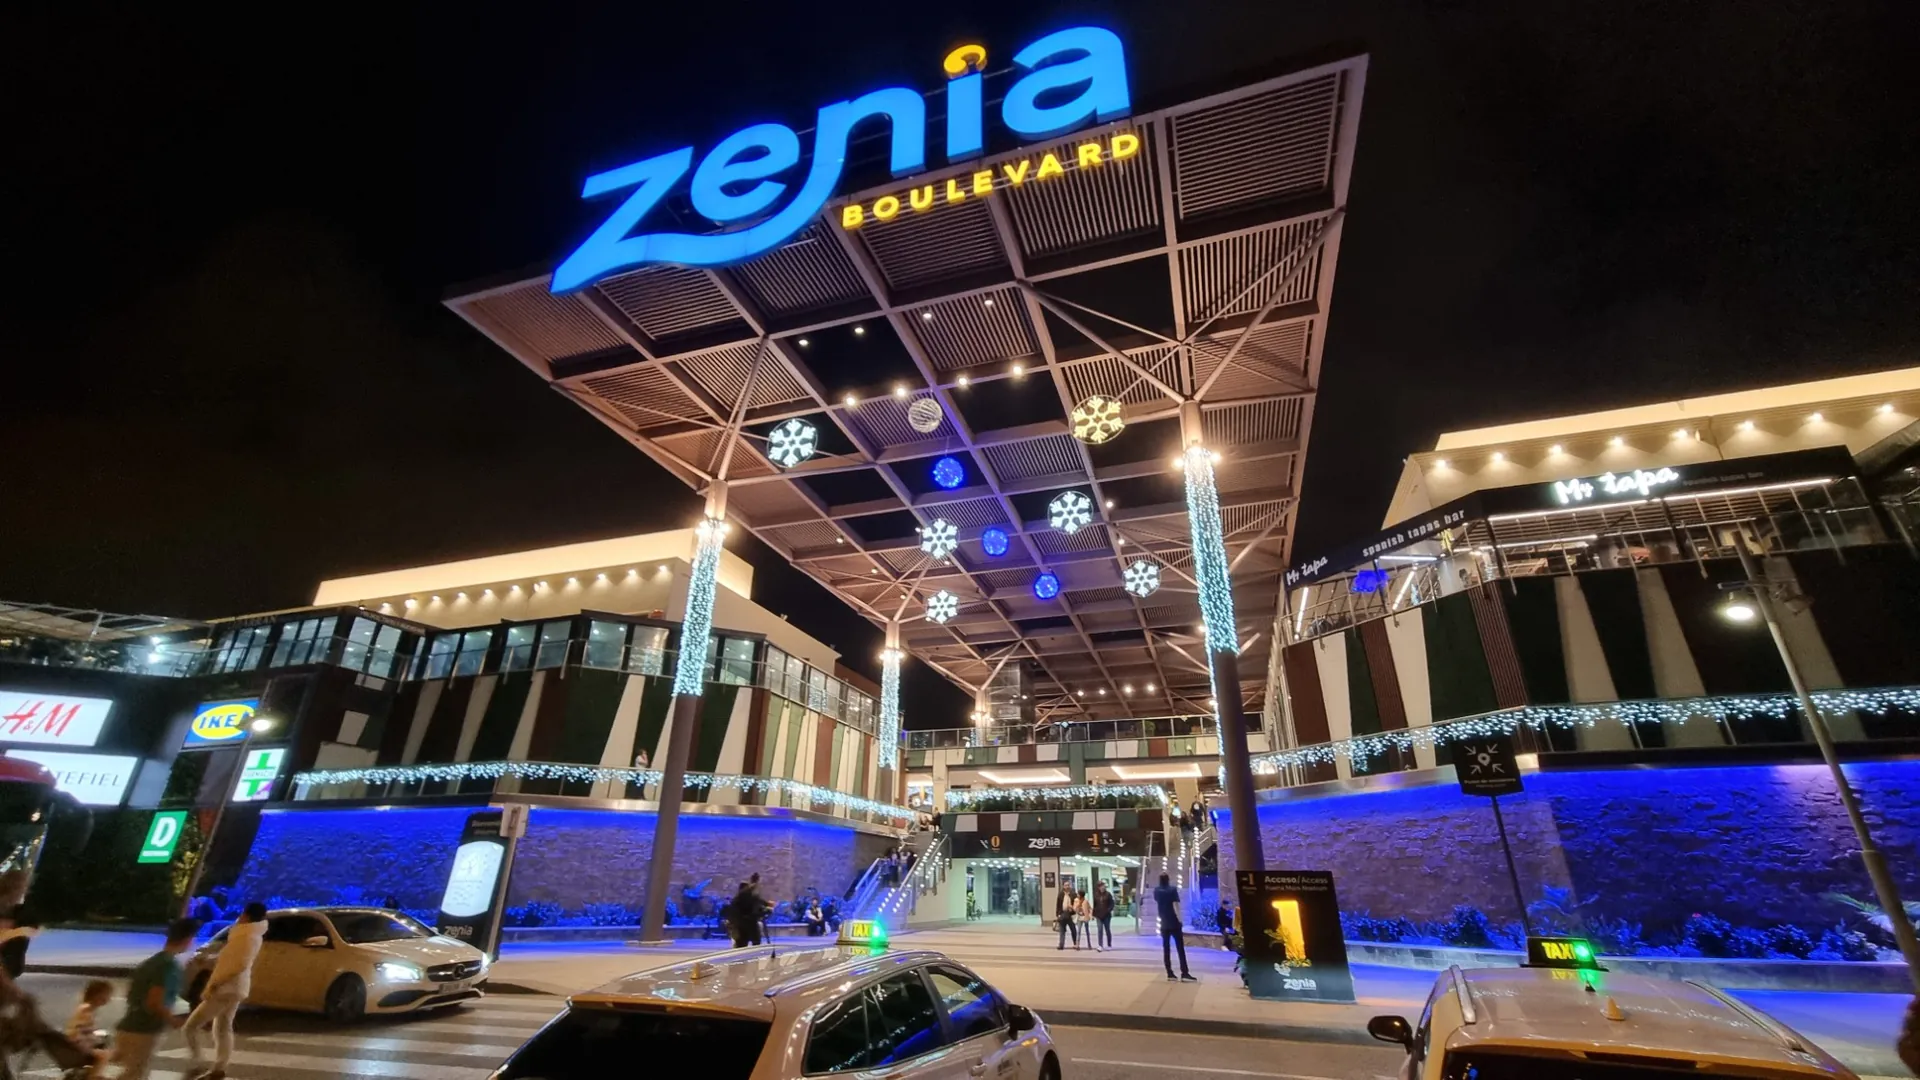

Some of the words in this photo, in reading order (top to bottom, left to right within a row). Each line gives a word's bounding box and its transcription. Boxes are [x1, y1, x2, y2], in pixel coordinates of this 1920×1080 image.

[549, 26, 1133, 294] zenia
[841, 133, 1140, 230] BOULEVARD
[1598, 467, 1680, 496] tapa
[1362, 533, 1405, 557] spanish
[1408, 519, 1440, 539] tapas
[1444, 509, 1465, 525] bar
[1302, 556, 1329, 577] tapa
[0, 700, 82, 737] H&M
[55, 770, 121, 787] TEFIEL
[991, 835, 1000, 847] 0
[1541, 942, 1576, 960] TAXI
